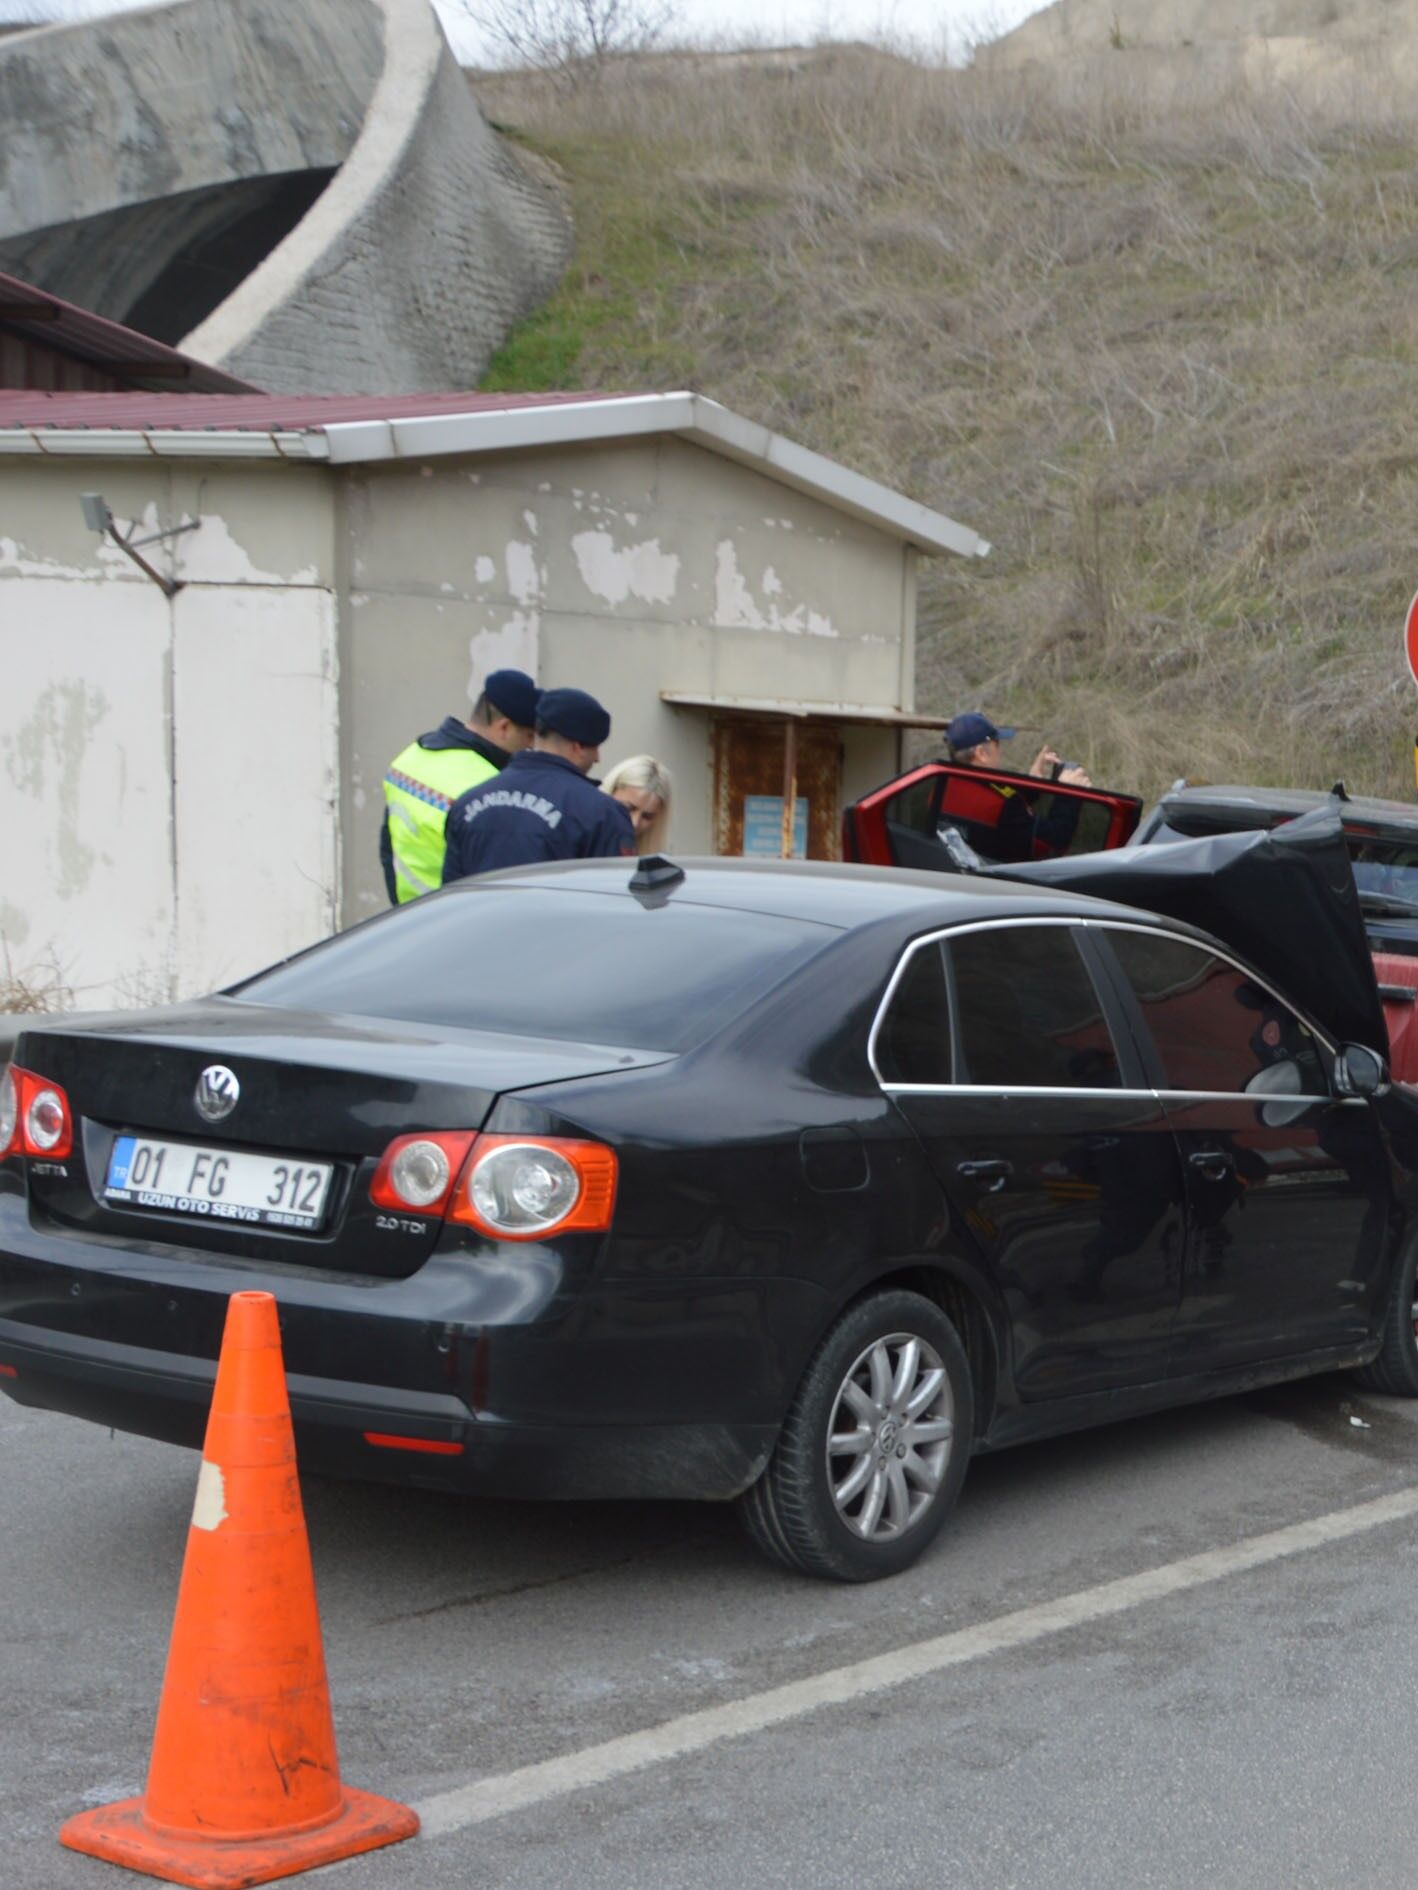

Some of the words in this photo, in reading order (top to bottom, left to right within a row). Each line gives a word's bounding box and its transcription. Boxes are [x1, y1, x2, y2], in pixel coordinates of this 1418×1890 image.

[464, 790, 562, 829] JANDARMA
[131, 1146, 166, 1189] 01
[187, 1153, 230, 1197] FG
[266, 1165, 322, 1213] 312
[138, 1191, 176, 1209] UZUN
[177, 1197, 210, 1214] OTO
